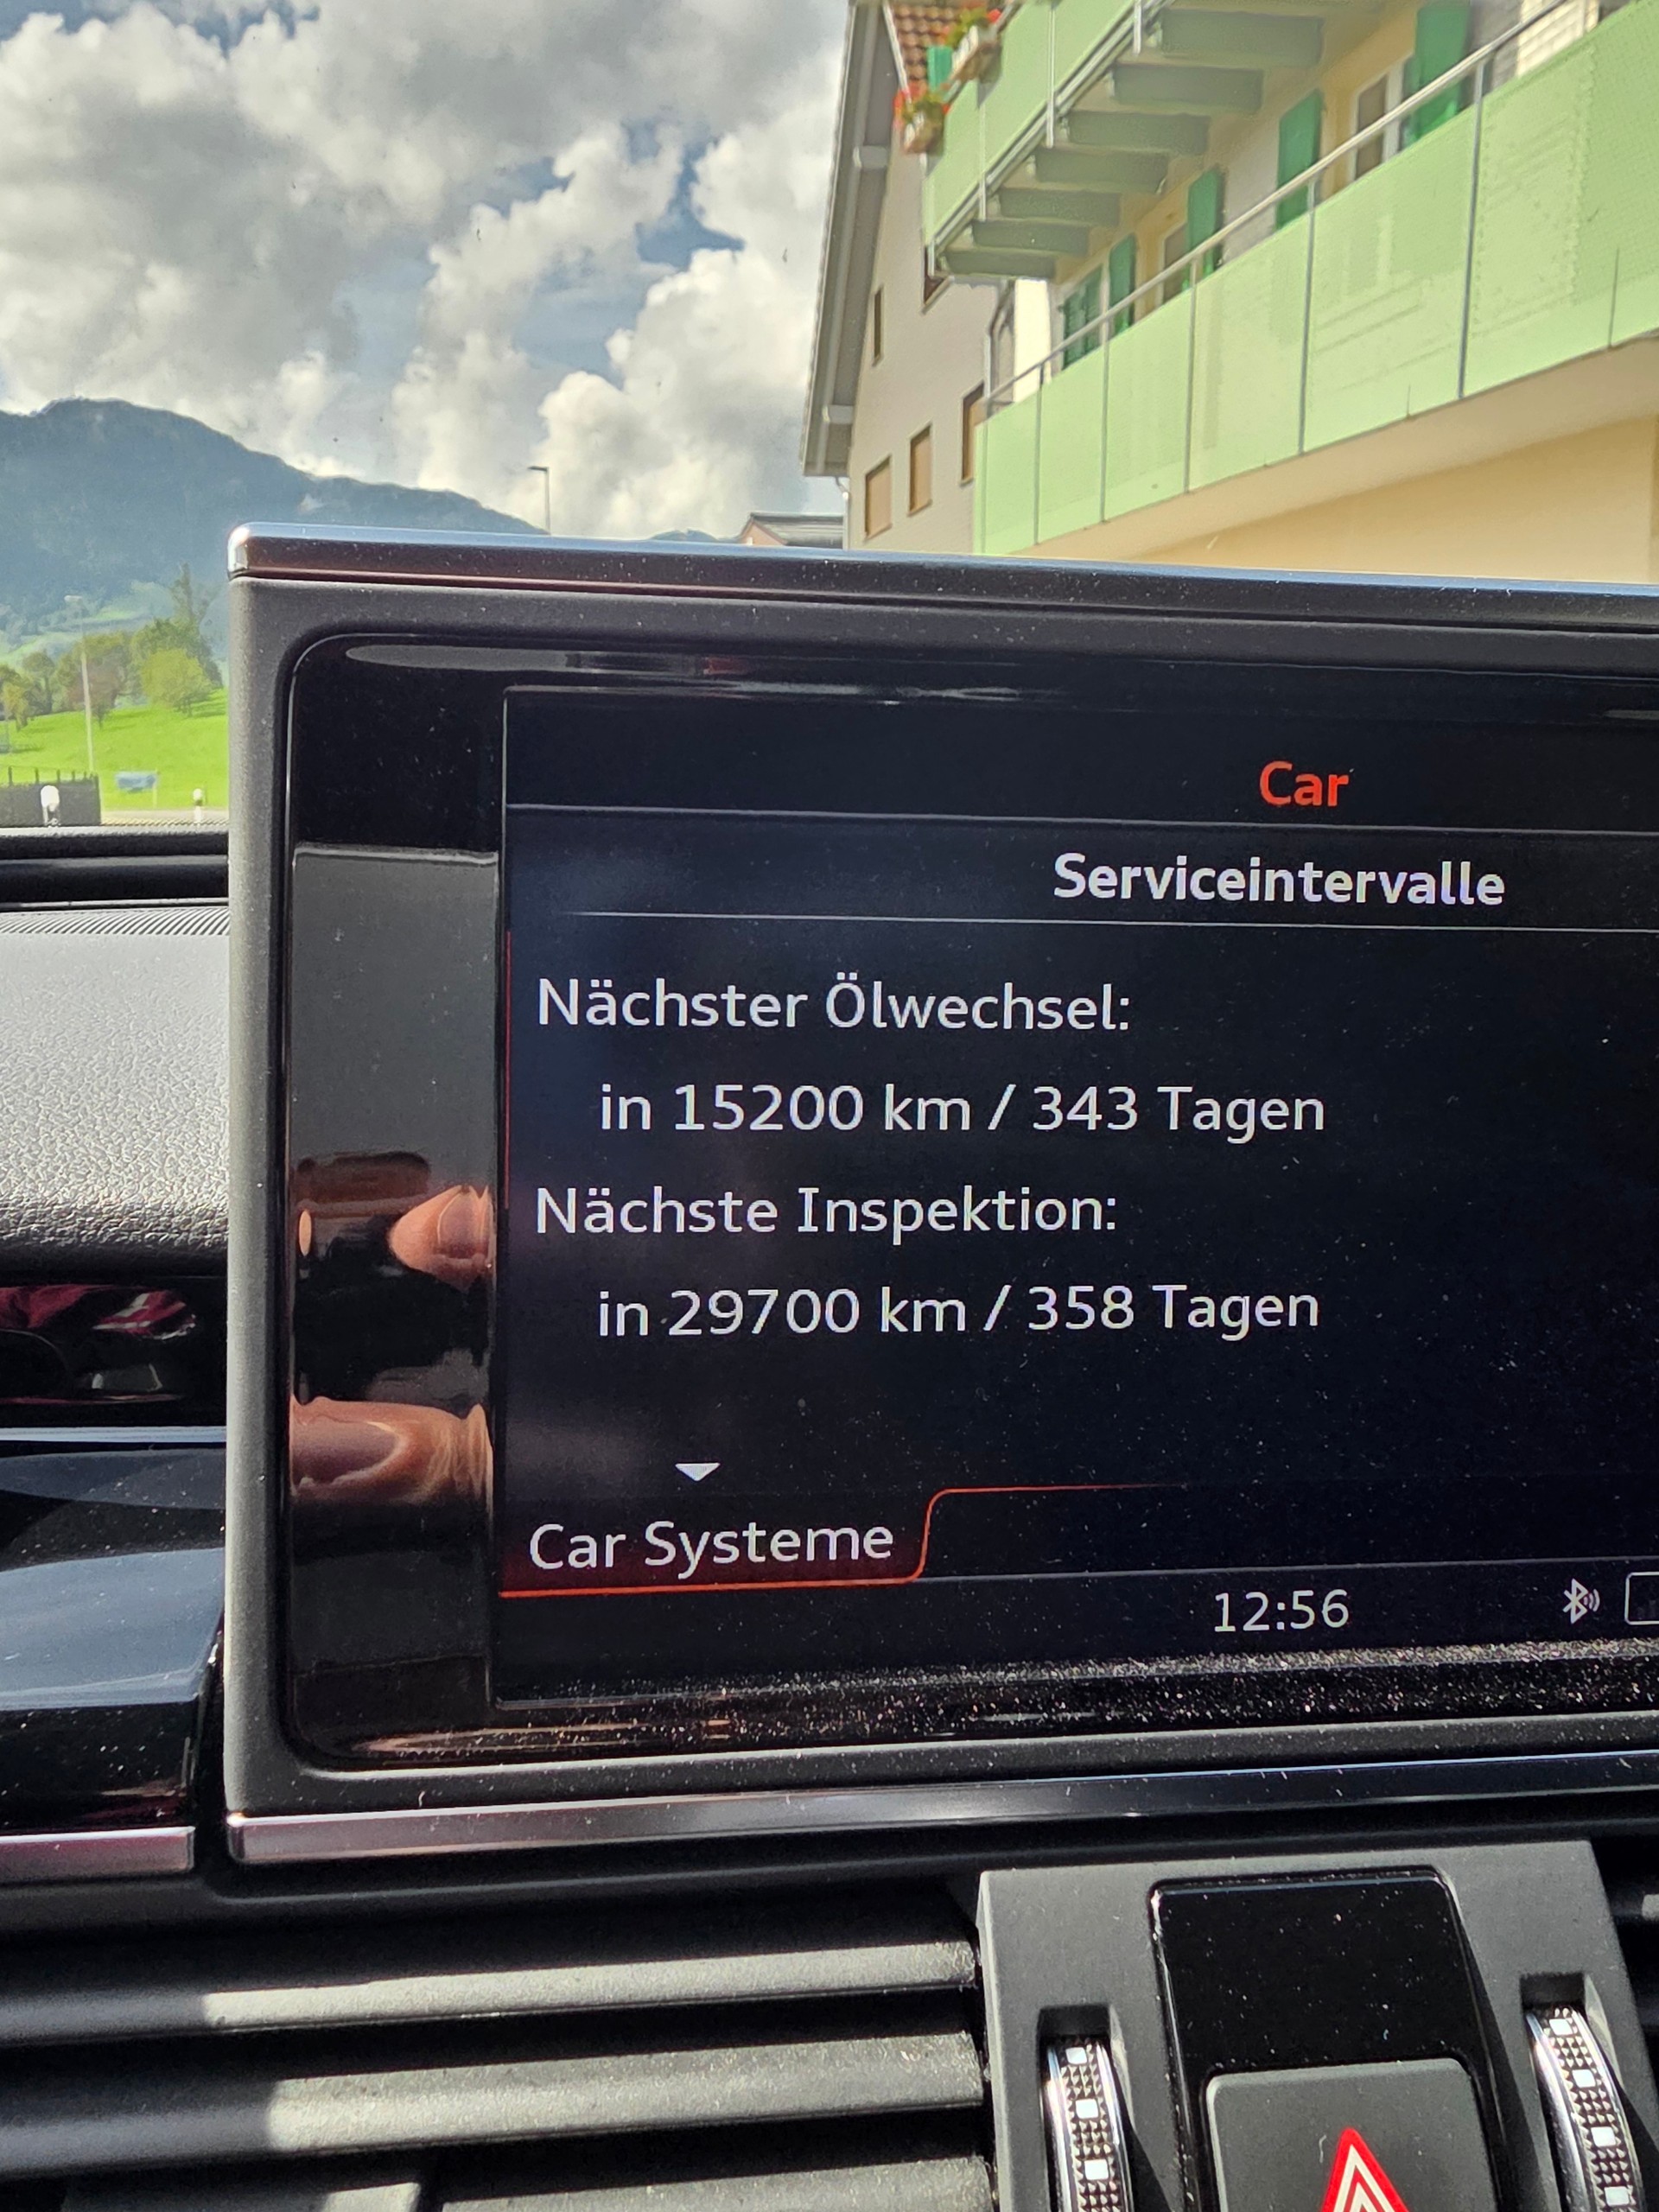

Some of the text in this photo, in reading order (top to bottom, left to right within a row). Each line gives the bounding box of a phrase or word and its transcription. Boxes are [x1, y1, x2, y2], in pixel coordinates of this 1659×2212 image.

[1259, 760, 1350, 807] Car
[1053, 852, 1505, 906] Serviceintervalle
[538, 971, 1129, 1031] Nächster Ölwechsel:
[601, 1083, 1324, 1144] in 15200 km / 343 Tagen
[537, 1185, 1116, 1246] Nächste Inspektion:
[599, 1284, 1319, 1342] in 29700 km / 358 Tagen
[530, 1521, 893, 1580] Car Systeme
[1214, 1589, 1349, 1632] 12:56
